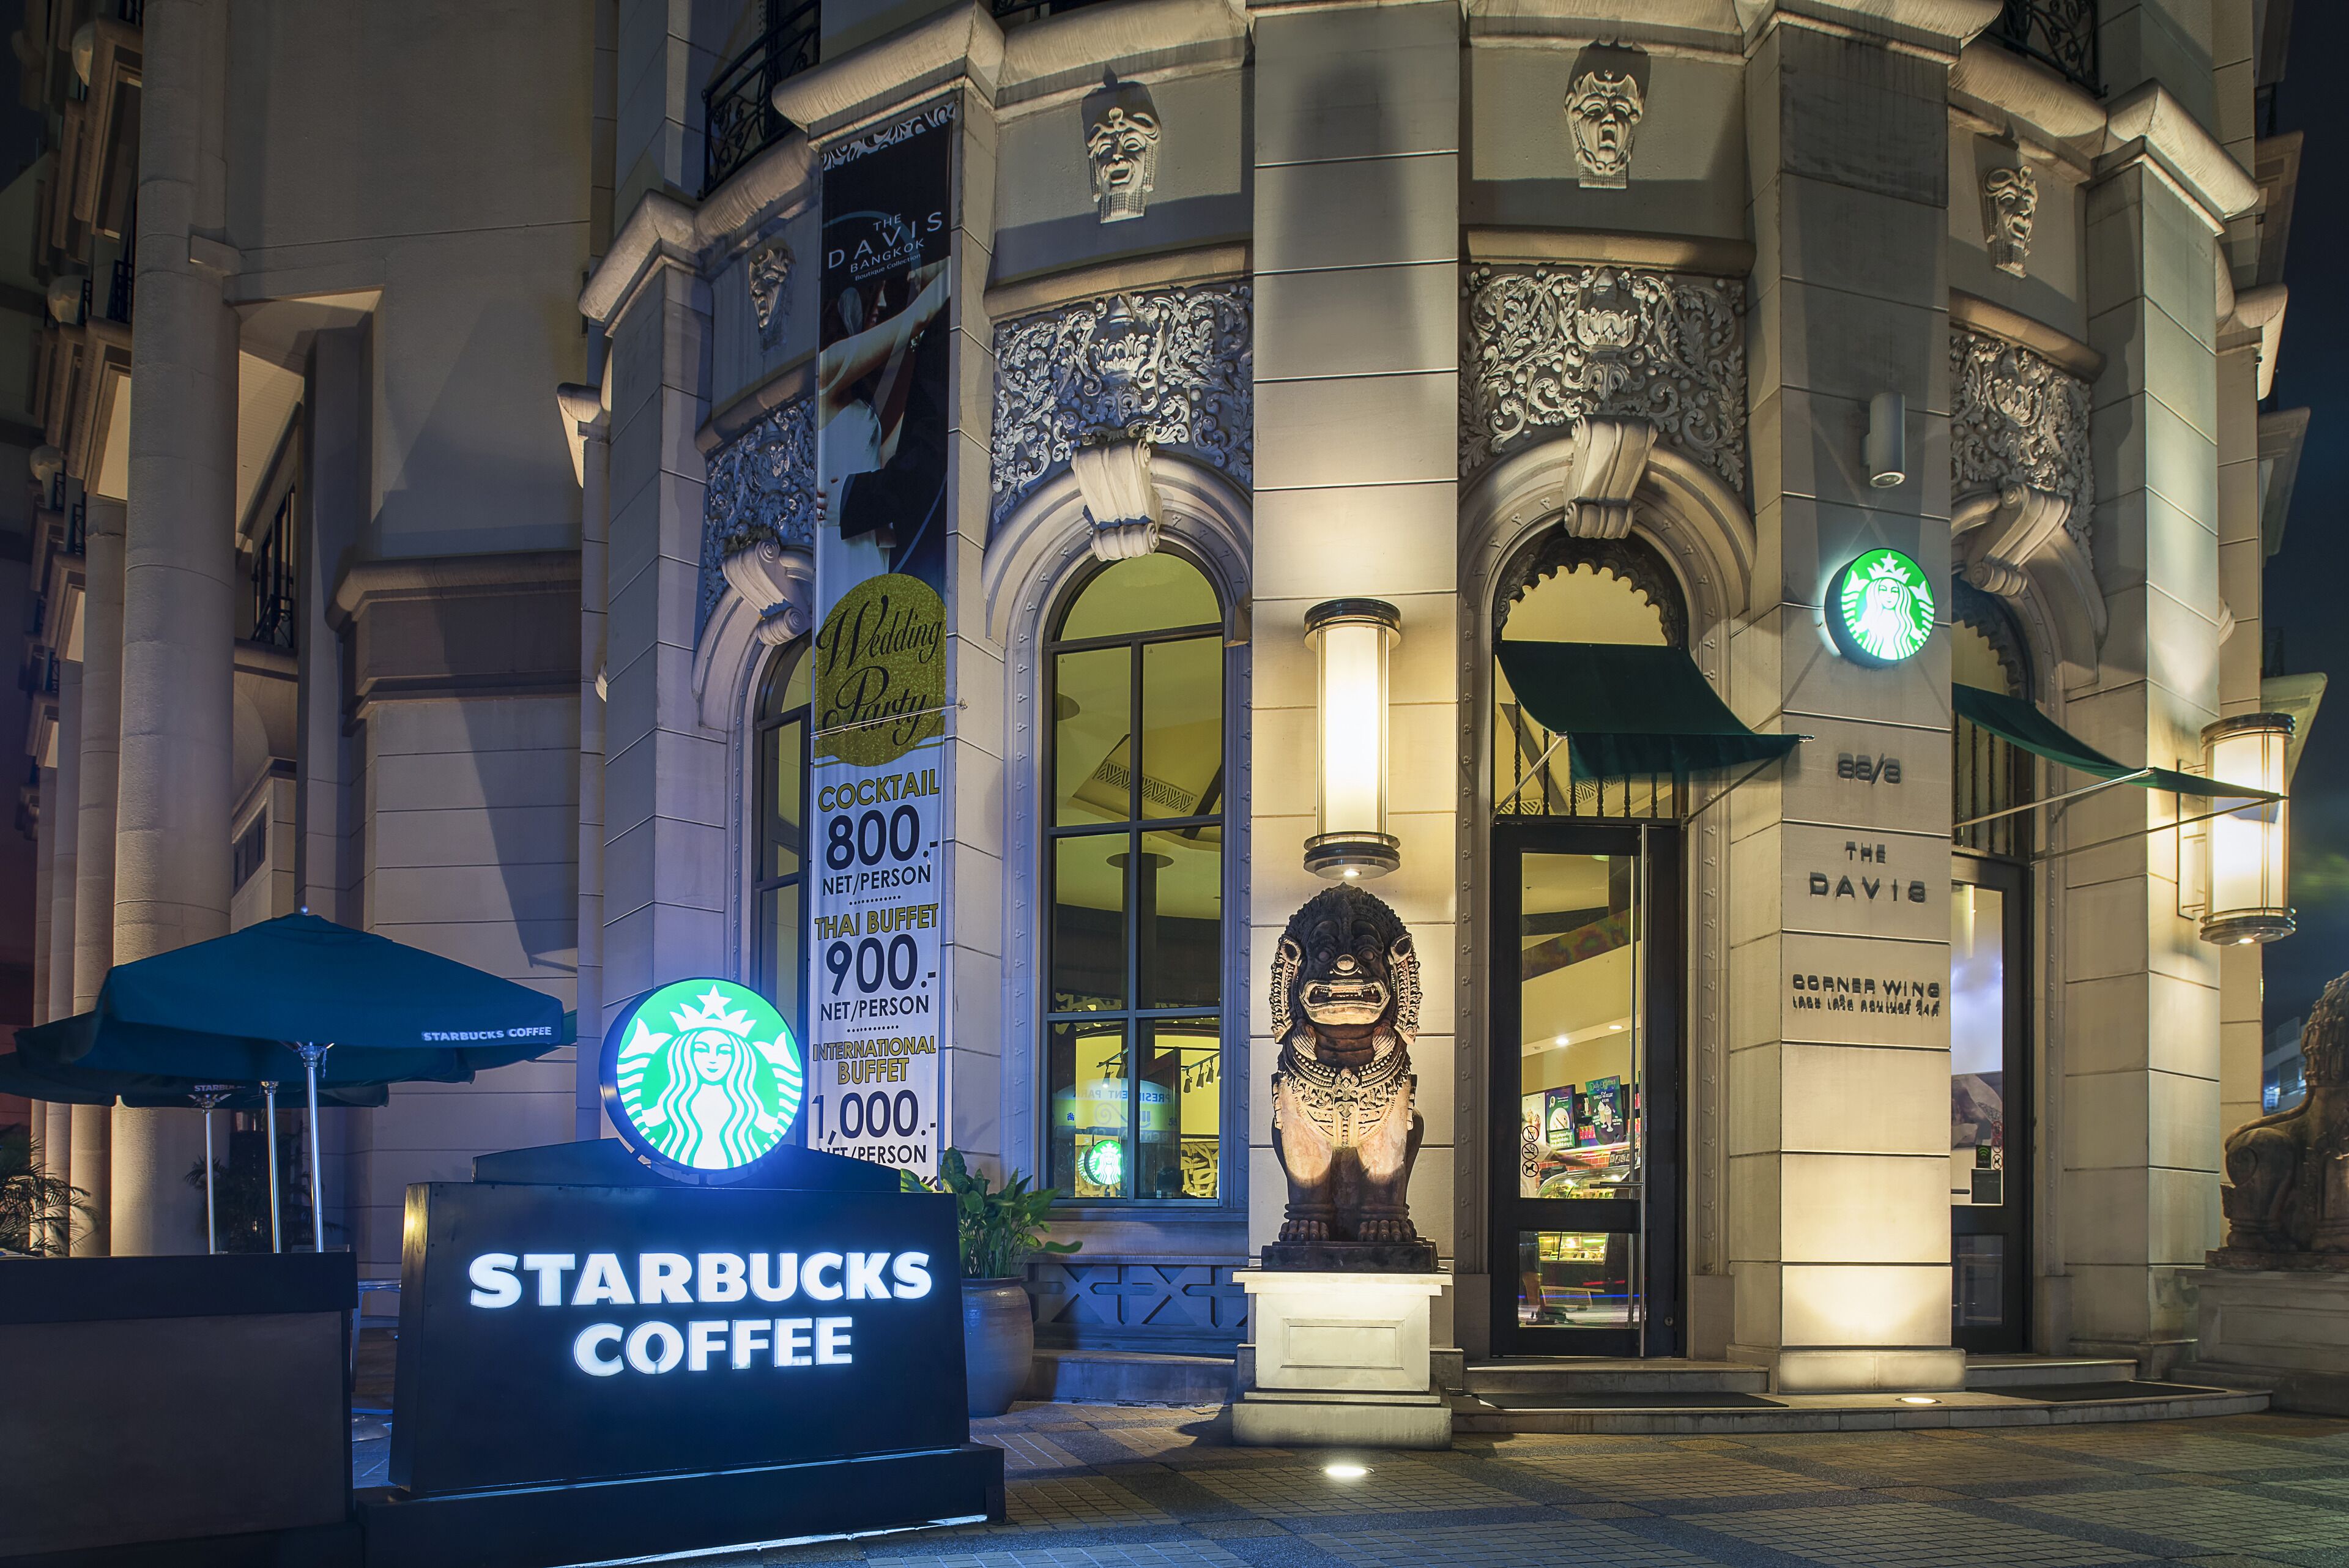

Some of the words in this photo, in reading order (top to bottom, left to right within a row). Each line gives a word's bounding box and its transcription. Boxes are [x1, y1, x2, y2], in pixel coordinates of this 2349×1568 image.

[873, 214, 901, 231] THE
[828, 212, 943, 269] DAVIS
[850, 238, 924, 273] BANGKOK
[855, 267, 885, 281] Boutique
[886, 254, 921, 269] Collection
[815, 595, 943, 677] Wedding
[822, 666, 932, 746] Party
[818, 768, 940, 812] COCKTAIL
[1846, 841, 1885, 864] THE
[823, 864, 930, 896] NET/PERSON
[1809, 871, 1926, 904] DAVIS
[815, 913, 860, 941] THAI
[867, 903, 939, 934] BUFFET
[1793, 973, 1876, 995] CORNER
[1883, 979, 1940, 998] WING
[820, 995, 929, 1022] NET/PERSON
[421, 1030, 505, 1041] STARBUCKS
[507, 1027, 552, 1038] COFFEE
[813, 1035, 937, 1061] INTERNATIONAL
[837, 1058, 910, 1085] BUFFET
[469, 1251, 932, 1309] STARBUCKS
[573, 1316, 853, 1377] COFFEE
